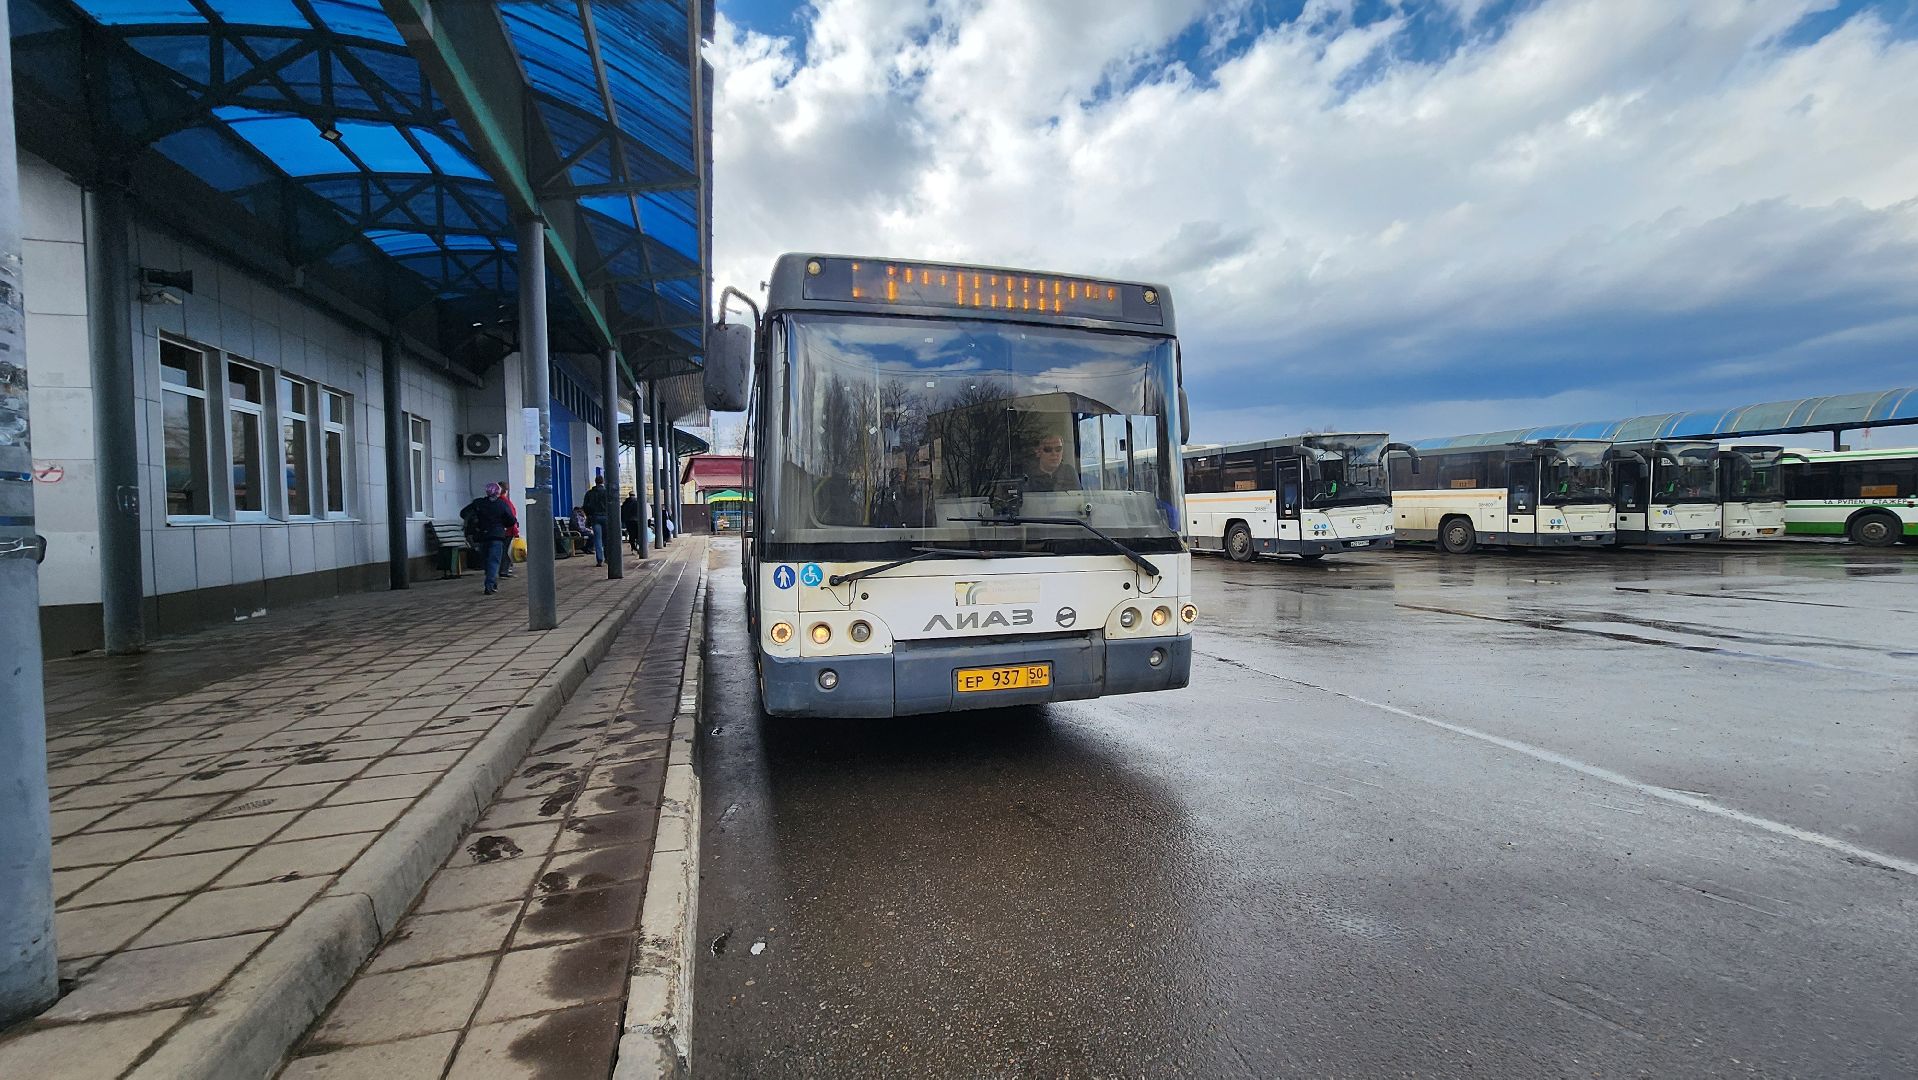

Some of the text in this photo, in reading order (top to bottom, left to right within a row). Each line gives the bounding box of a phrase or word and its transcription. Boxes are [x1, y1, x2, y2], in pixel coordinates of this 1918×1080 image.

[922, 608, 1034, 632] ЛИАЗ
[965, 676, 984, 688] ЕР
[992, 669, 1019, 686] 937
[1029, 667, 1043, 680] 50
